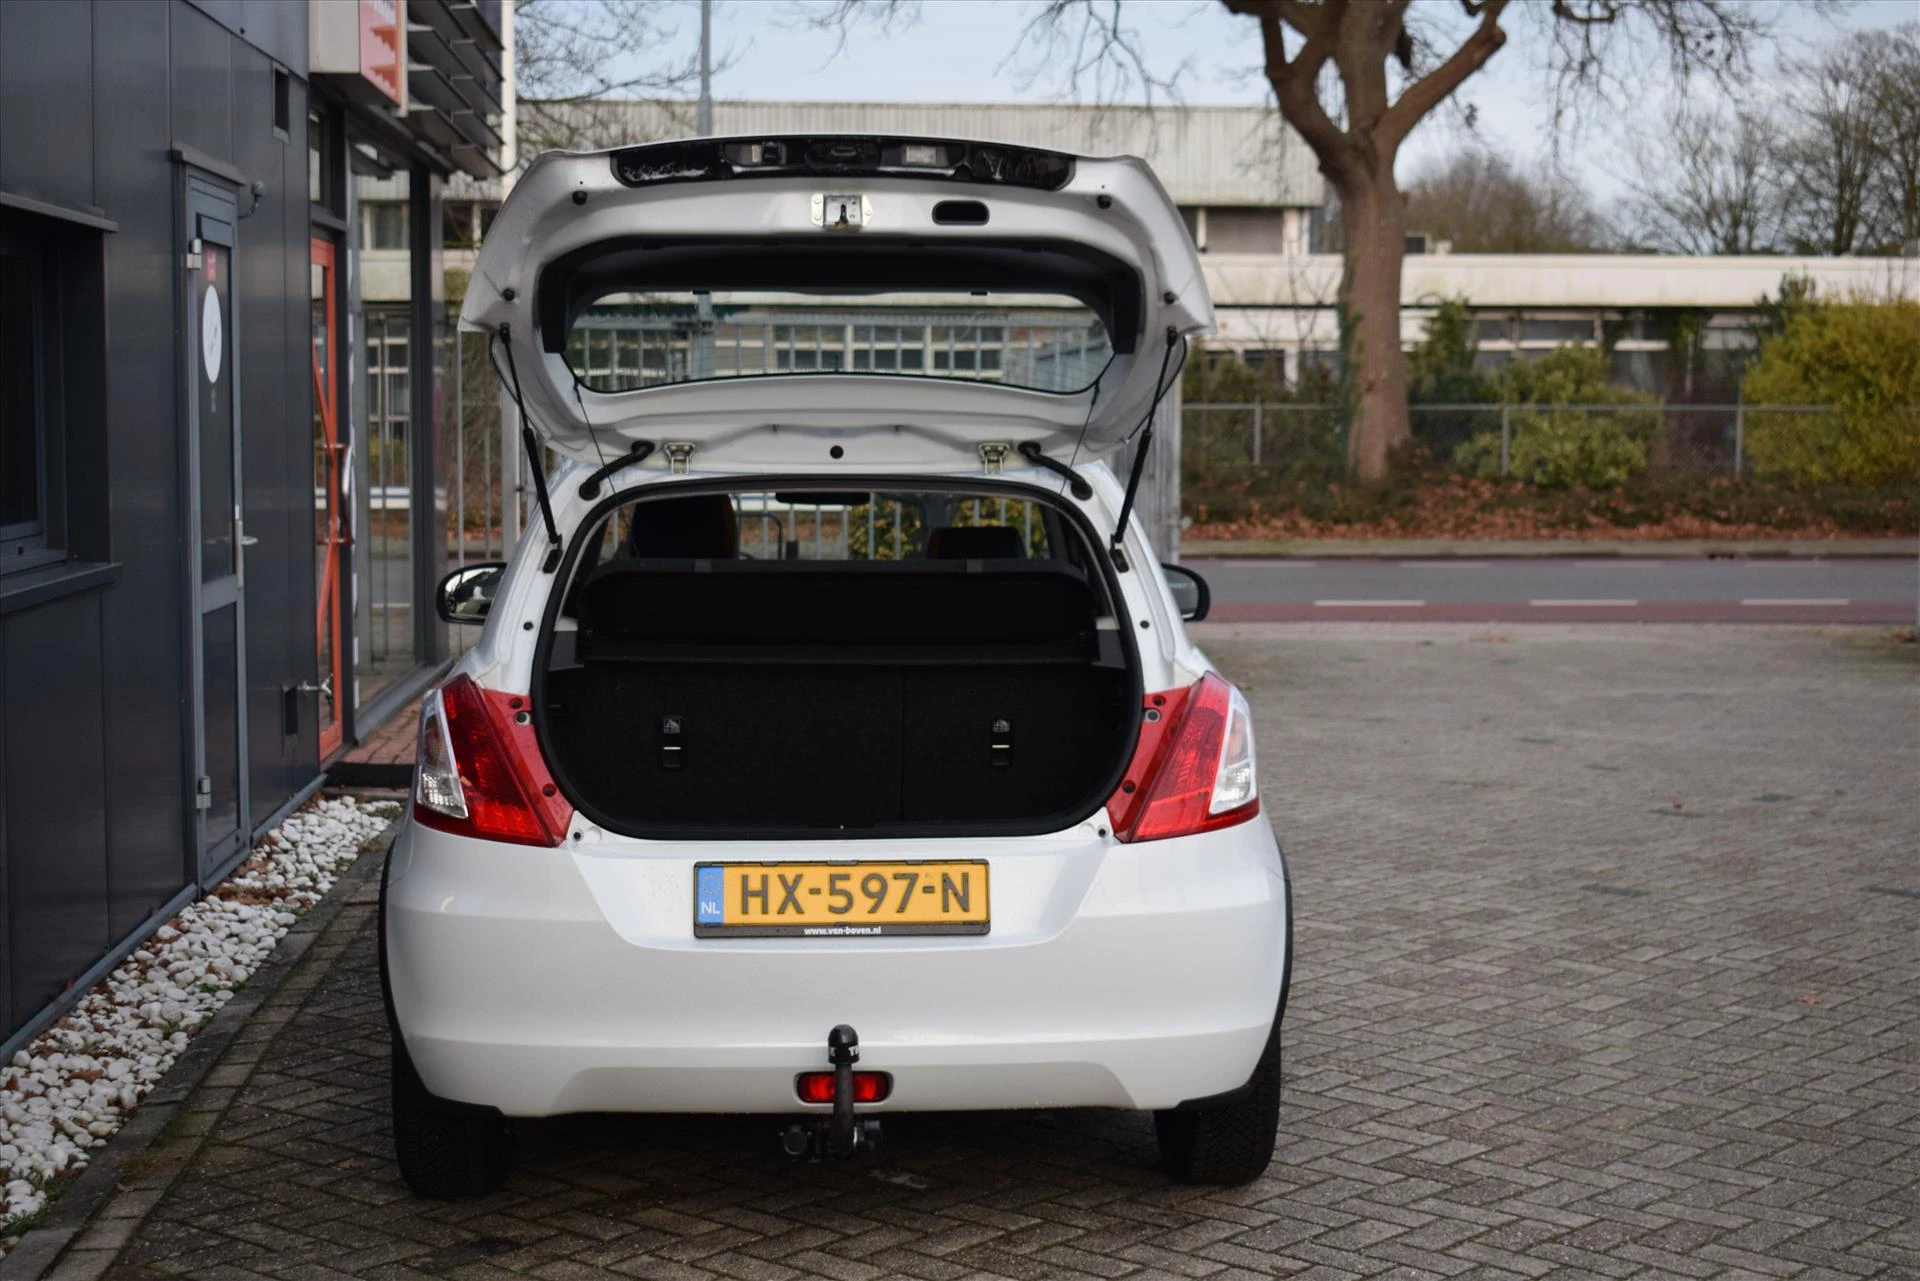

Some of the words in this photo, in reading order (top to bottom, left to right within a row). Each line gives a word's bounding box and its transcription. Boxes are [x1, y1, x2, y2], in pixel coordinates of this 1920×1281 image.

[741, 872, 970, 915] HX-597-N
[701, 901, 721, 915] NL
[803, 926, 882, 936] www.van-boven.nl
